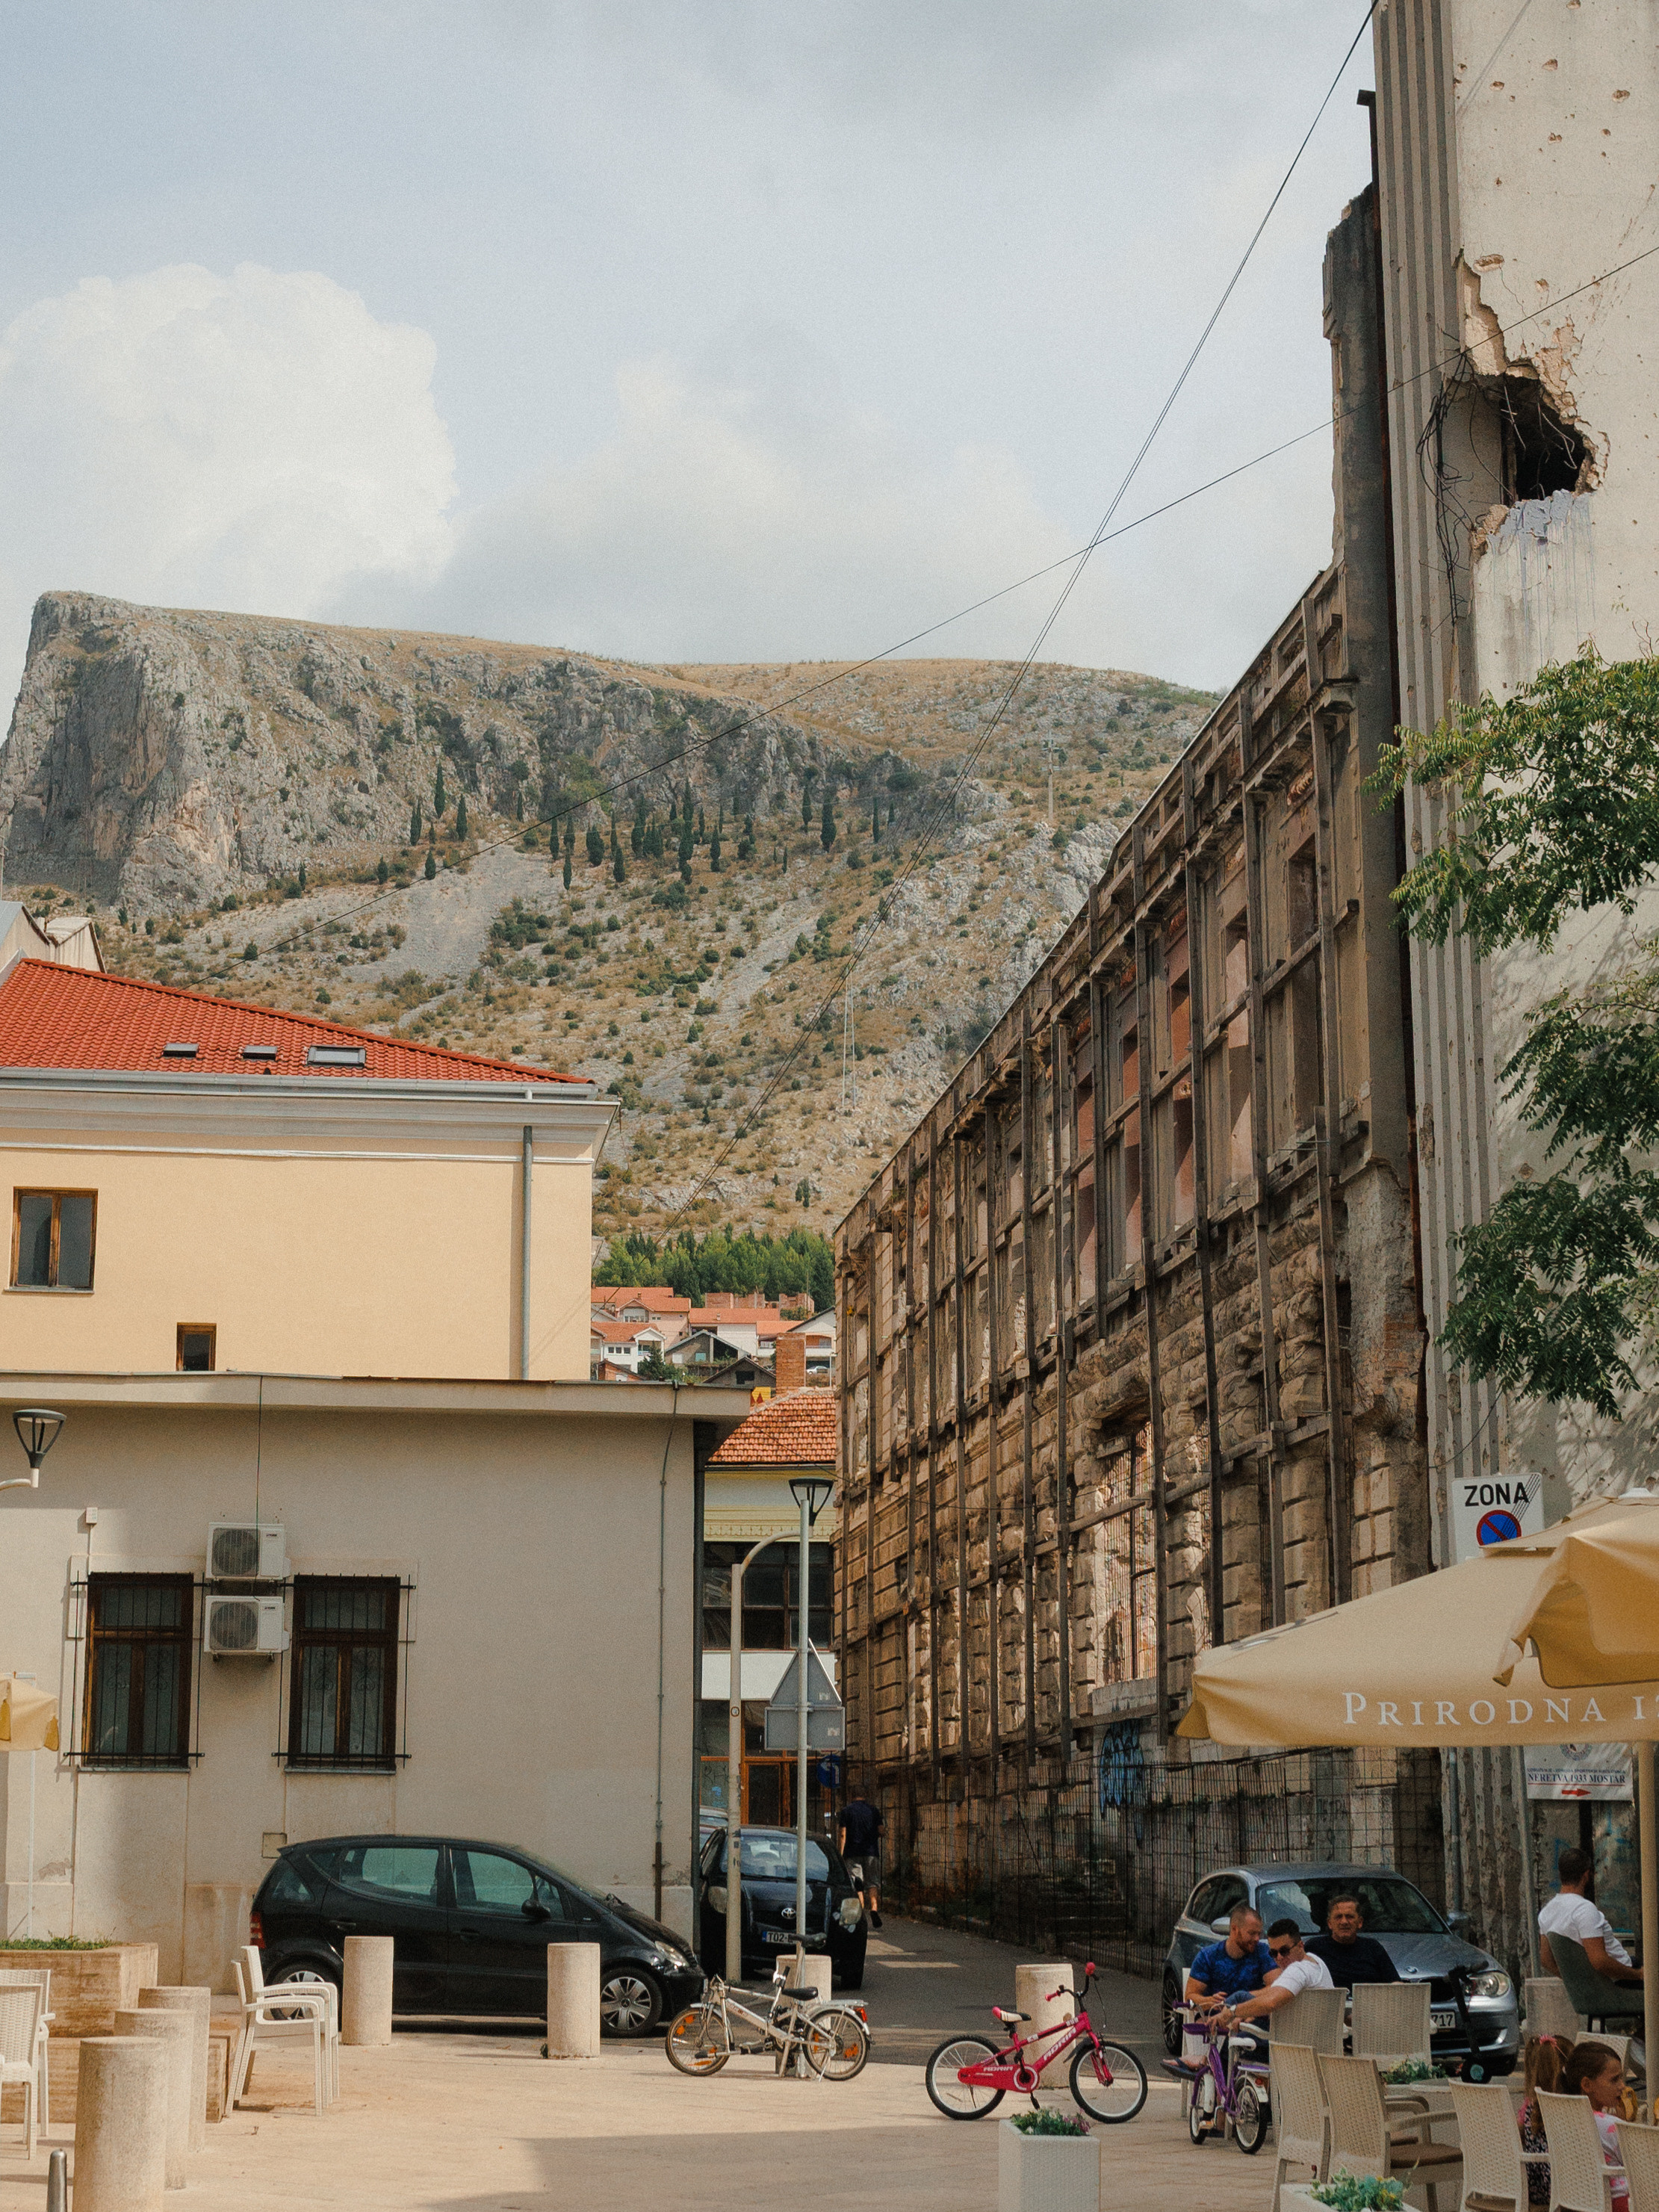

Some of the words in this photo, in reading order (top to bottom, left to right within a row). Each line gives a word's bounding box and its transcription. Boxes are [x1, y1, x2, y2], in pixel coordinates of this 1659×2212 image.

[1464, 1481, 1530, 1507] ZONA
[1632, 1695, 1659, 1720] I
[1528, 1773, 1568, 1782] NERETVA
[1570, 1773, 1587, 1783] 1933
[1589, 1773, 1625, 1783] MOSTAR
